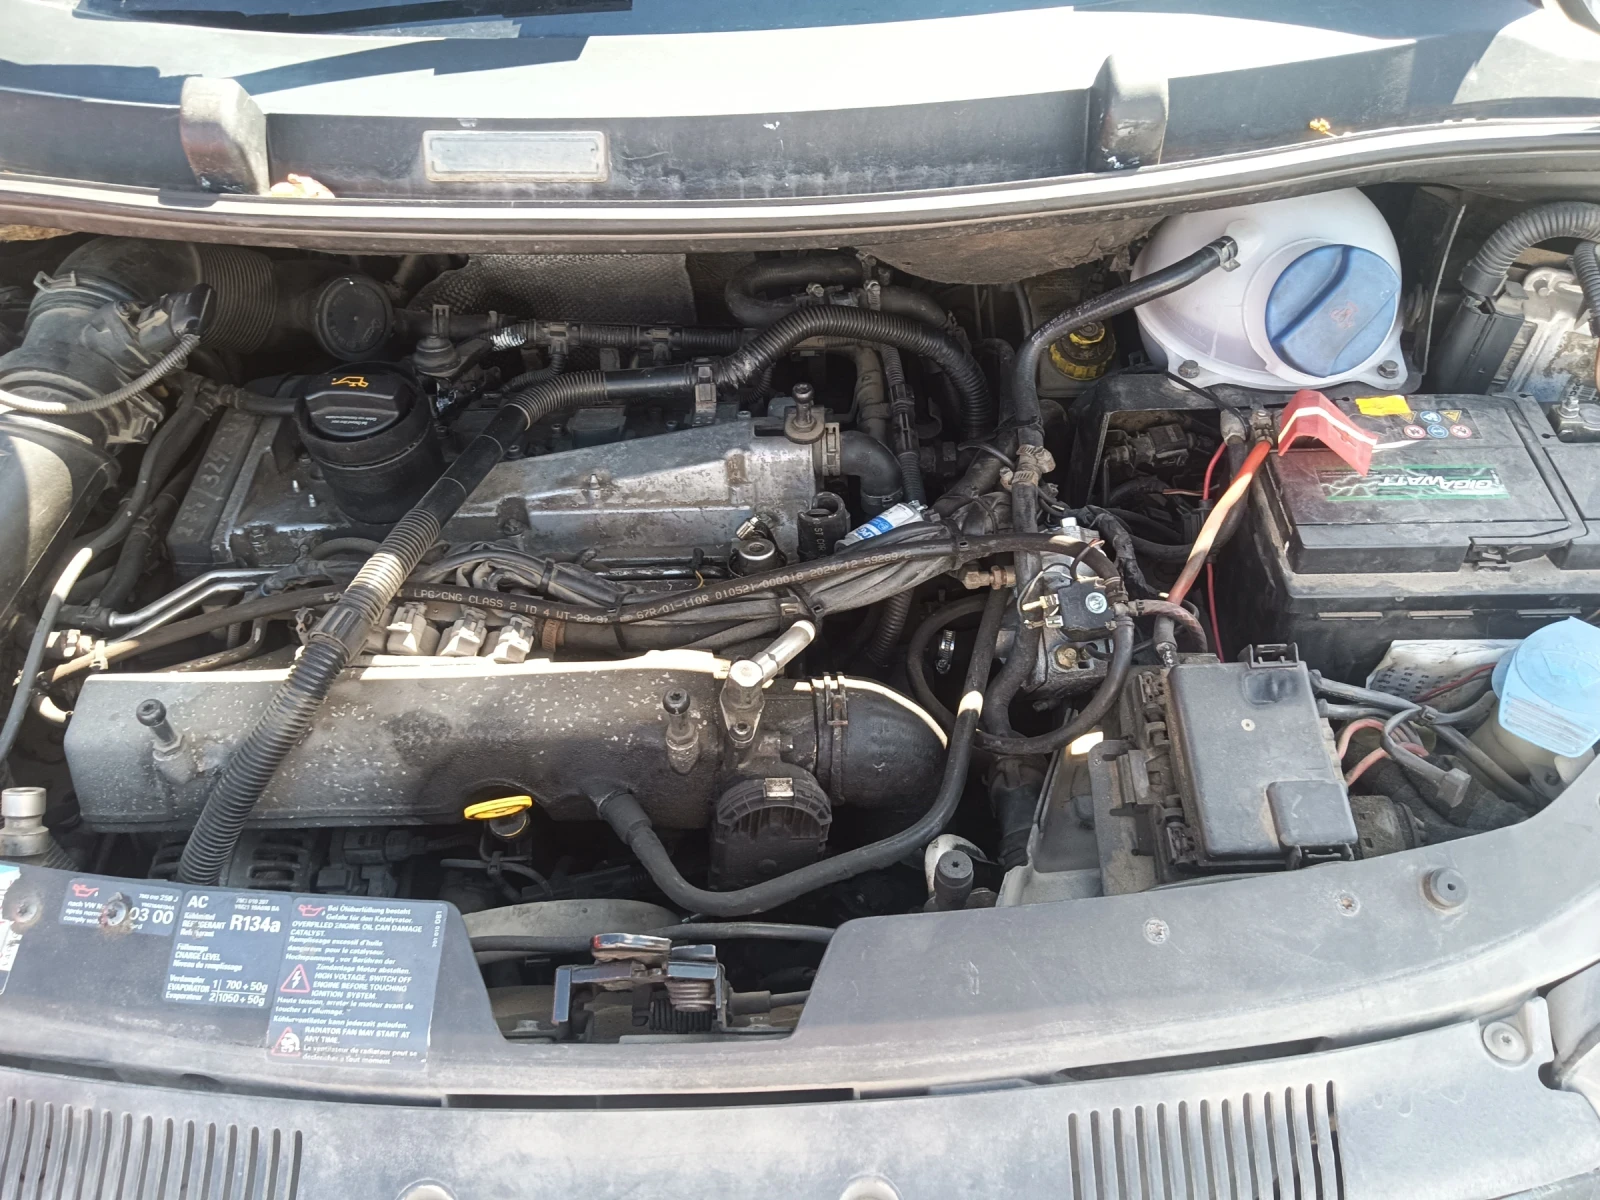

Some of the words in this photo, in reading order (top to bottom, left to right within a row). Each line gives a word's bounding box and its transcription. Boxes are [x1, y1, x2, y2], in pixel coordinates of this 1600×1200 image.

[1378, 475, 1493, 491] GIGAWATT
[413, 588, 463, 602] LPG/CNG
[468, 595, 503, 608] CLASS
[510, 602, 517, 610] 2
[525, 604, 537, 614] ID
[543, 608, 550, 616] 4
[636, 594, 710, 620] 67R/01-110R
[810, 559, 858, 578] 2024/12
[84, 901, 96, 909] VW
[187, 895, 209, 908] AC
[152, 909, 174, 924] 00
[229, 914, 281, 933] R134a
[292, 921, 333, 929] OVERFILLED
[175, 951, 201, 960] CHARGE
[202, 952, 221, 961] LEVEL
[167, 983, 210, 993] EVAPORATOR
[226, 980, 243, 990] 700
[250, 981, 268, 993] 50g
[313, 981, 340, 989] ENGINE
[342, 982, 368, 990] BEFORE
[369, 983, 407, 992] TOUCHING
[208, 993, 215, 1002] 2
[219, 993, 240, 1003] 1050
[247, 995, 266, 1007] 50g
[311, 990, 344, 998] IGNITION
[346, 991, 377, 999] SYSTEM.
[305, 1026, 341, 1035] RADIATOR
[342, 1028, 357, 1036] FAN
[358, 1029, 375, 1037] MAY
[376, 1030, 399, 1038] START
[400, 1031, 410, 1039] AT
